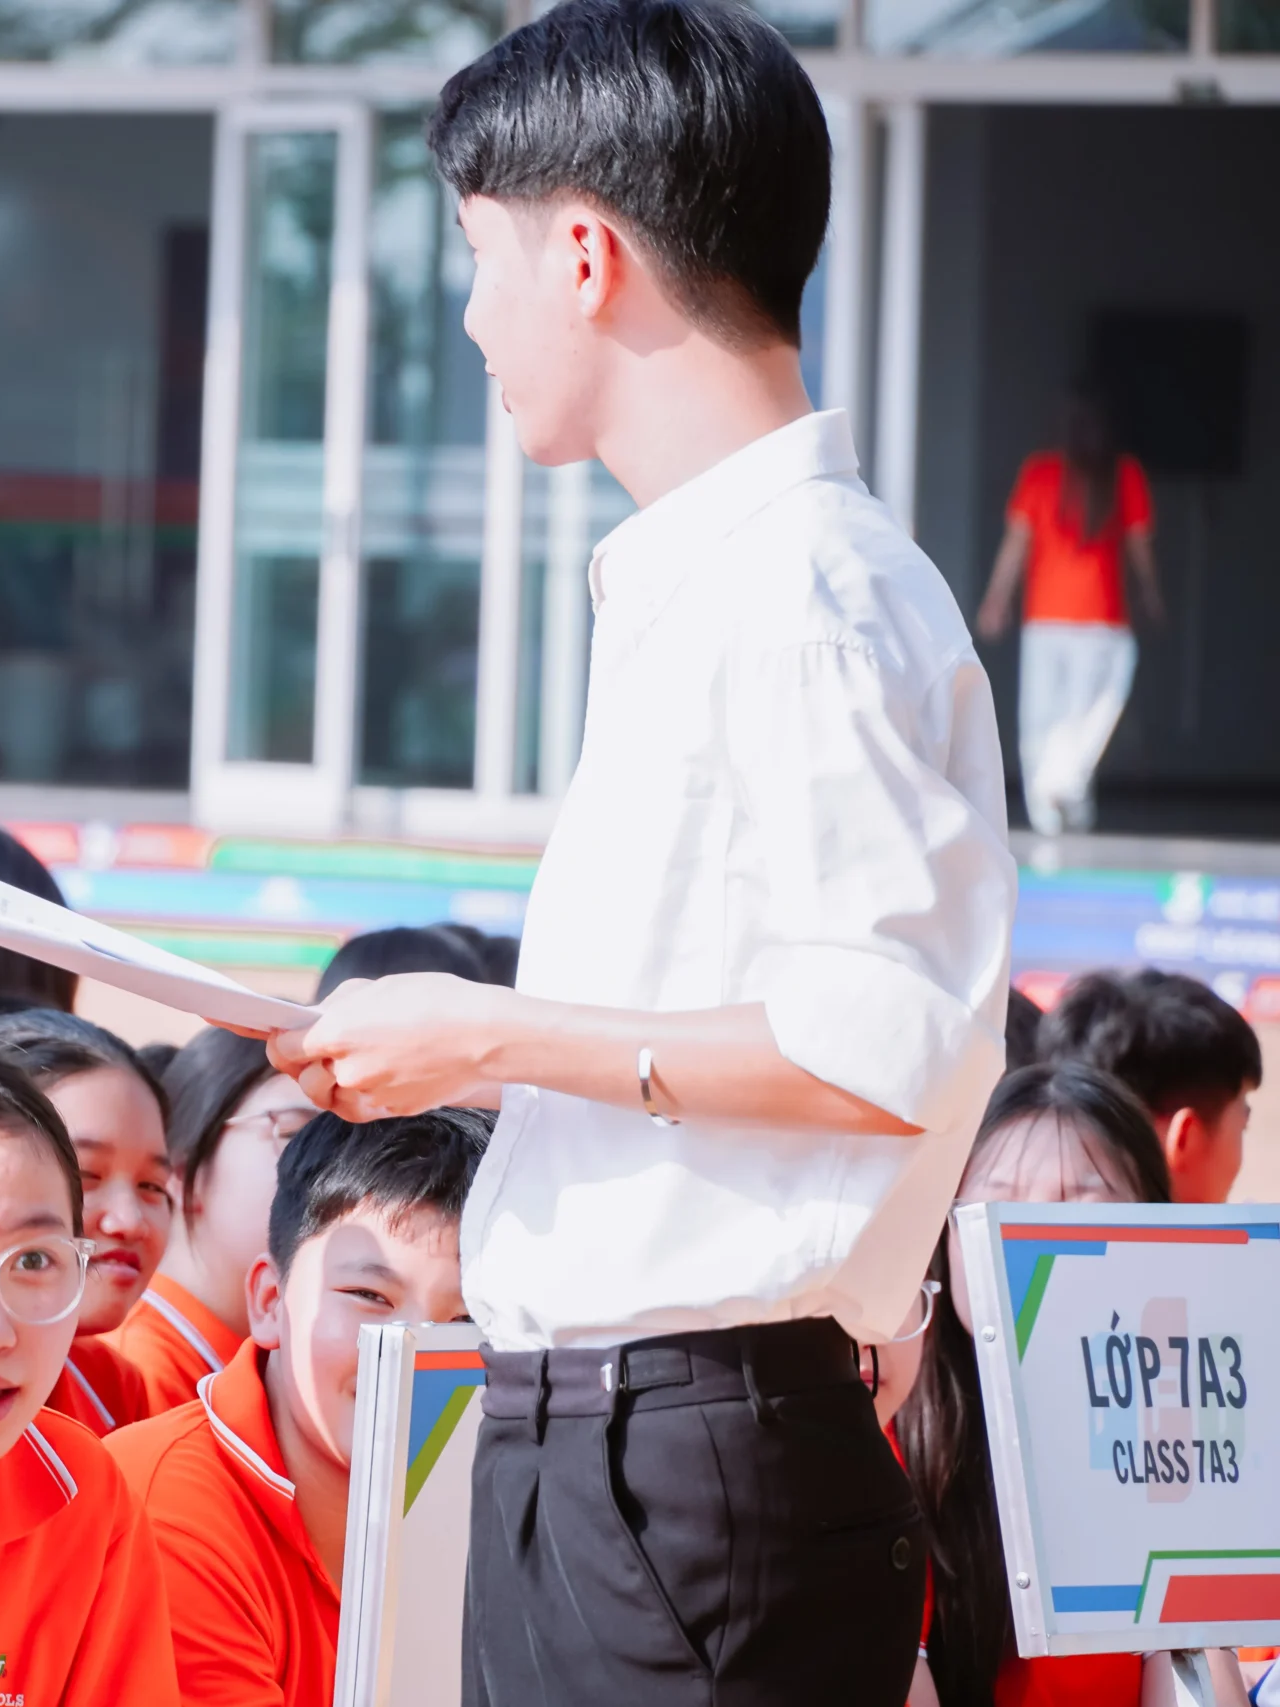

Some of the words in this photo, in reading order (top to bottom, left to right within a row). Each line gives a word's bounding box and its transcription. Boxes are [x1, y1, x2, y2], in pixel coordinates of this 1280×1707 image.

[1080, 1310, 1161, 1409] LỚP
[1168, 1336, 1248, 1410] 7A3
[1112, 1439, 1190, 1485] CLASS
[1191, 1439, 1239, 1484] 7A3
